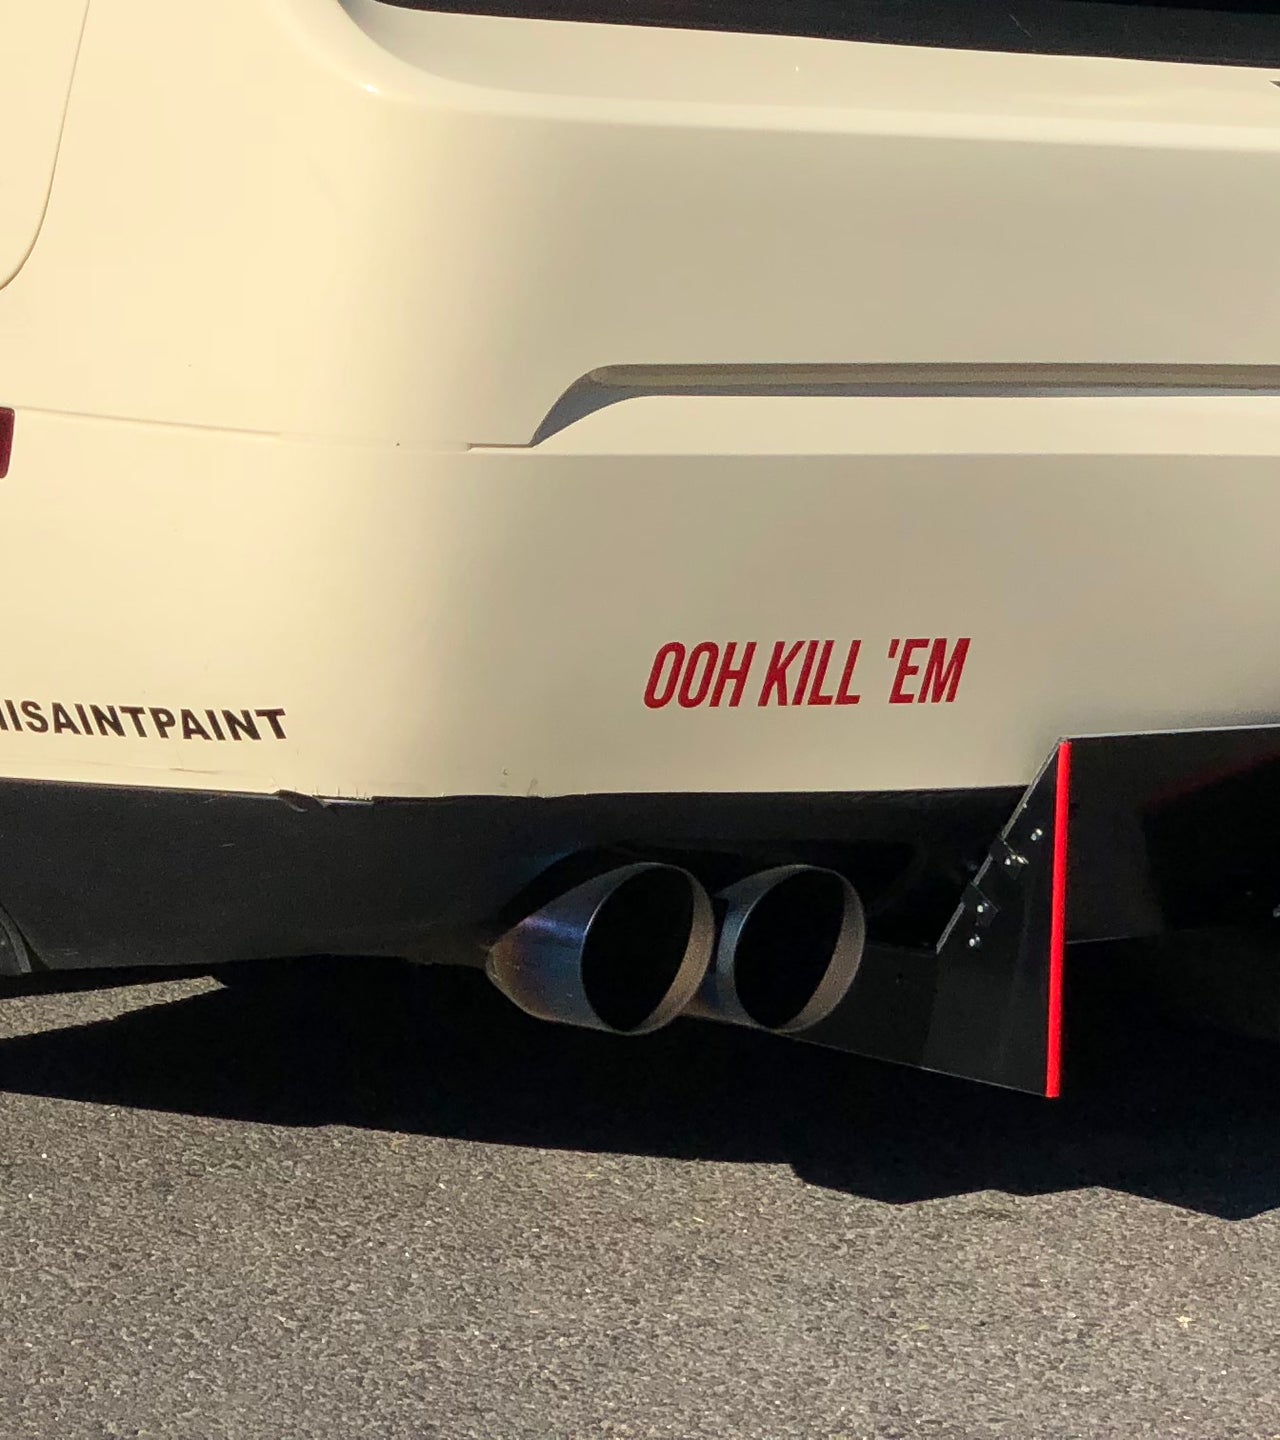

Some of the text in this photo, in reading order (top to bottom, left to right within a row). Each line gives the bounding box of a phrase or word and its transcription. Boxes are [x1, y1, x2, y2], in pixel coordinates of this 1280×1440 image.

[643, 637, 971, 709] OOH KILL 'EM
